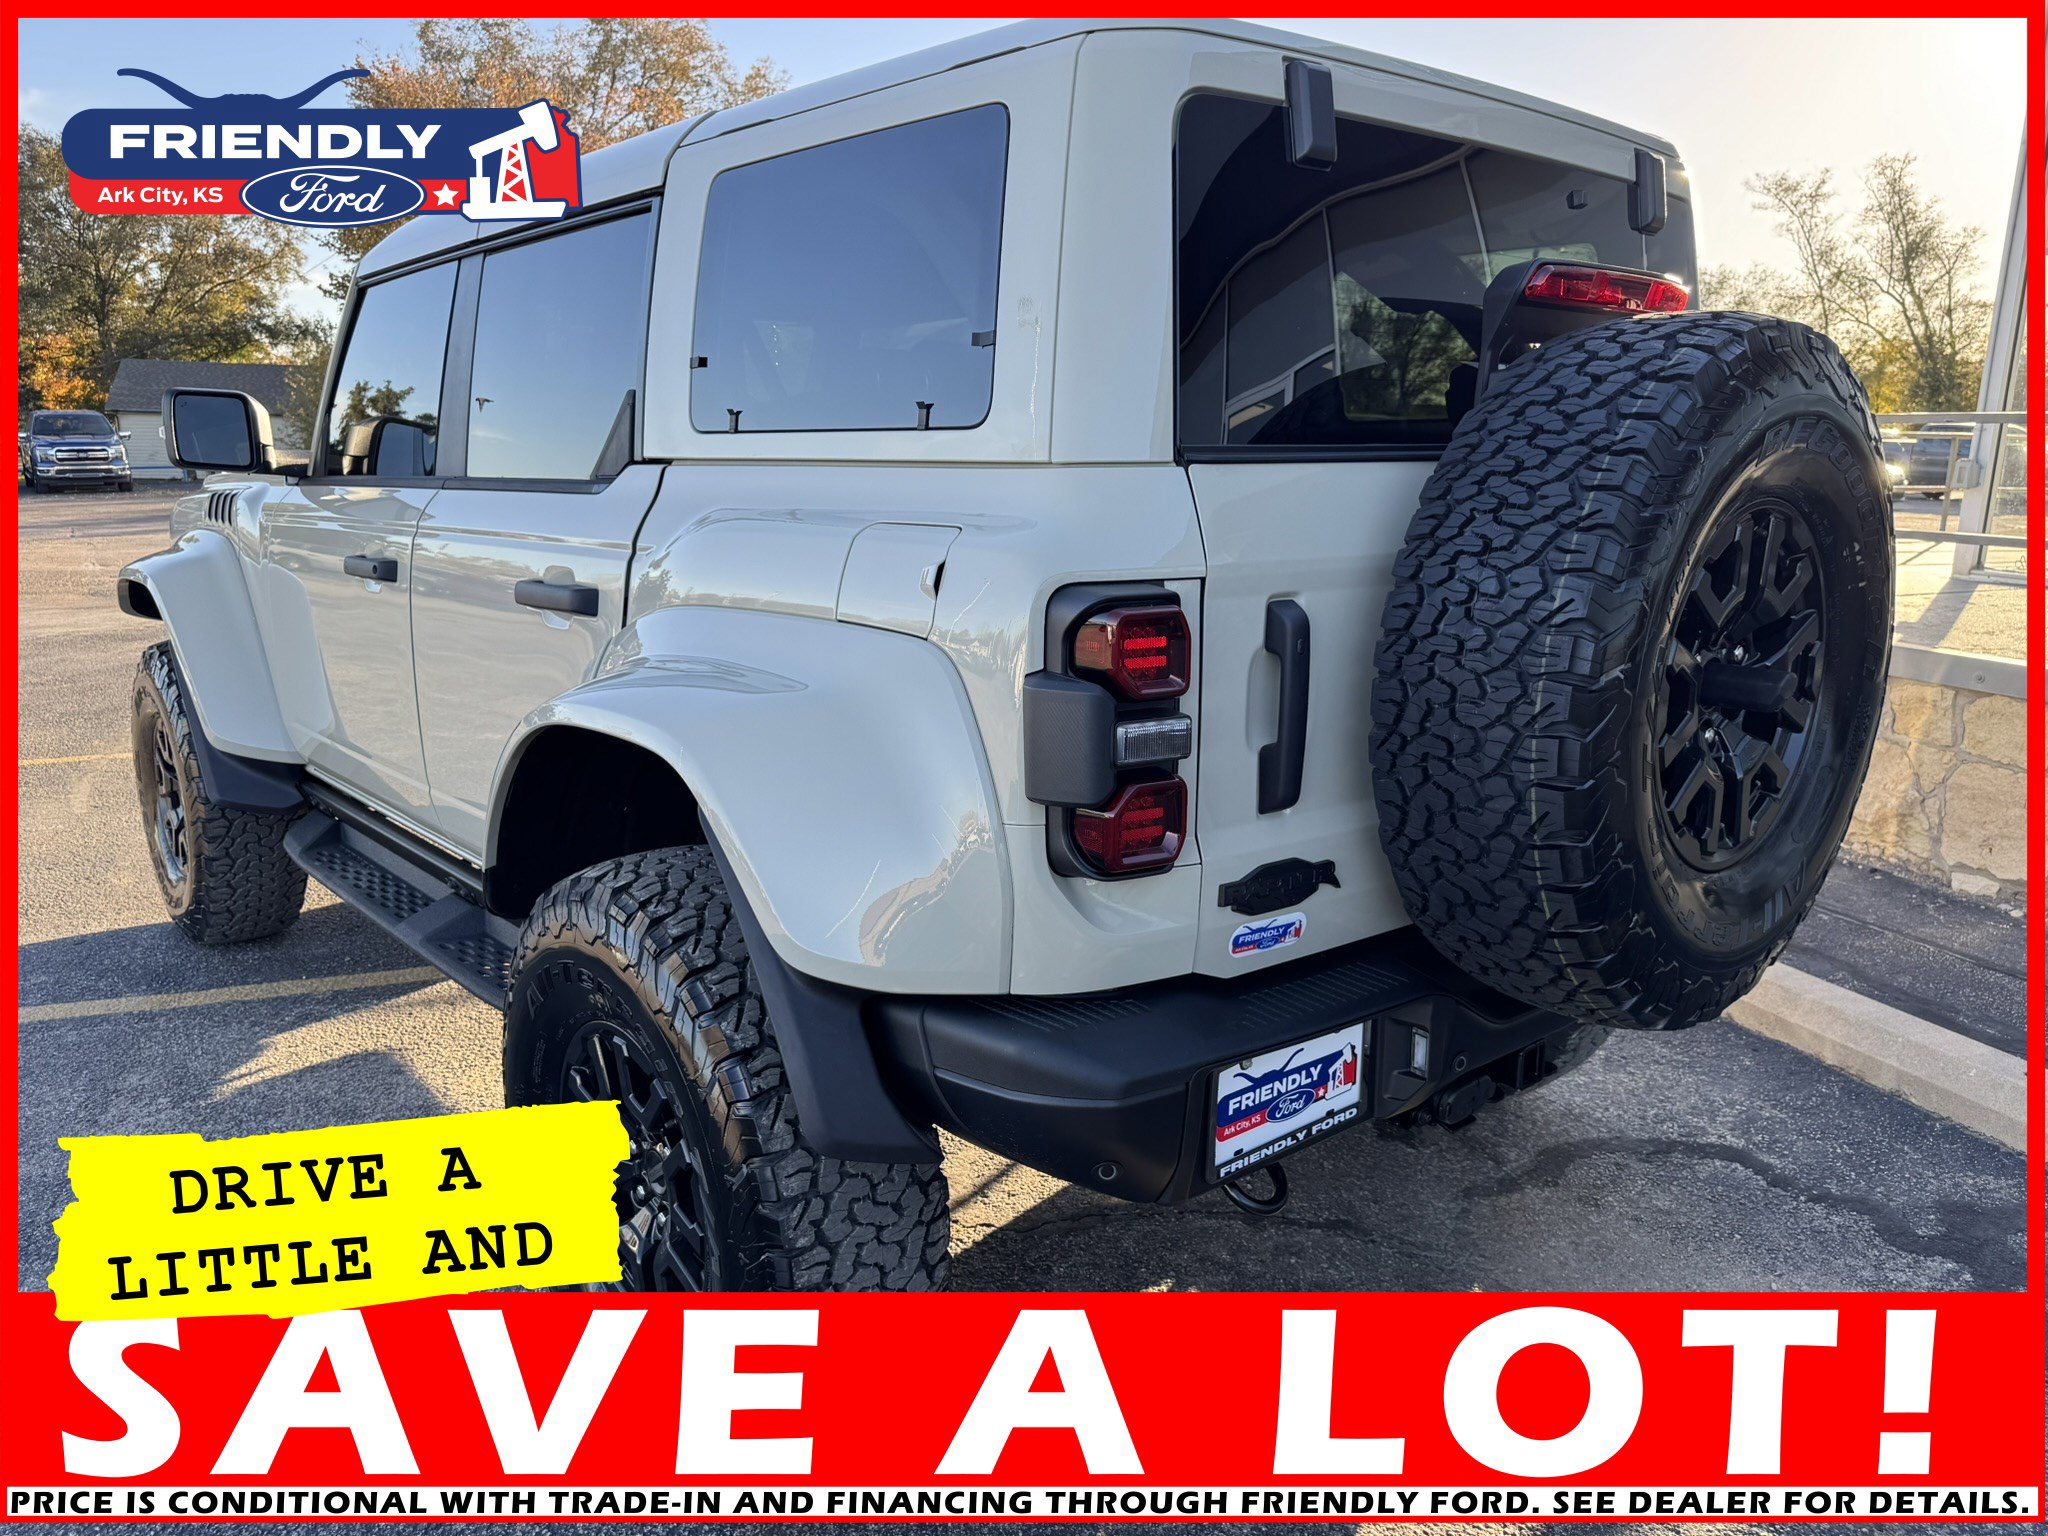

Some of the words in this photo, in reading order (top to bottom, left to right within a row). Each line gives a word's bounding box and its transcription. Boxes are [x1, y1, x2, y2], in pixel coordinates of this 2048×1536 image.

[1238, 926, 1286, 945] FRIENDLY
[1228, 1063, 1323, 1116] FRIENDLY
[1275, 1093, 1305, 1118] Ford
[1223, 1125, 1236, 1137] Ark
[1251, 1114, 1261, 1125] KS
[1219, 1129, 1308, 1178] FRIENDLY
[1311, 1108, 1358, 1135] FORD
